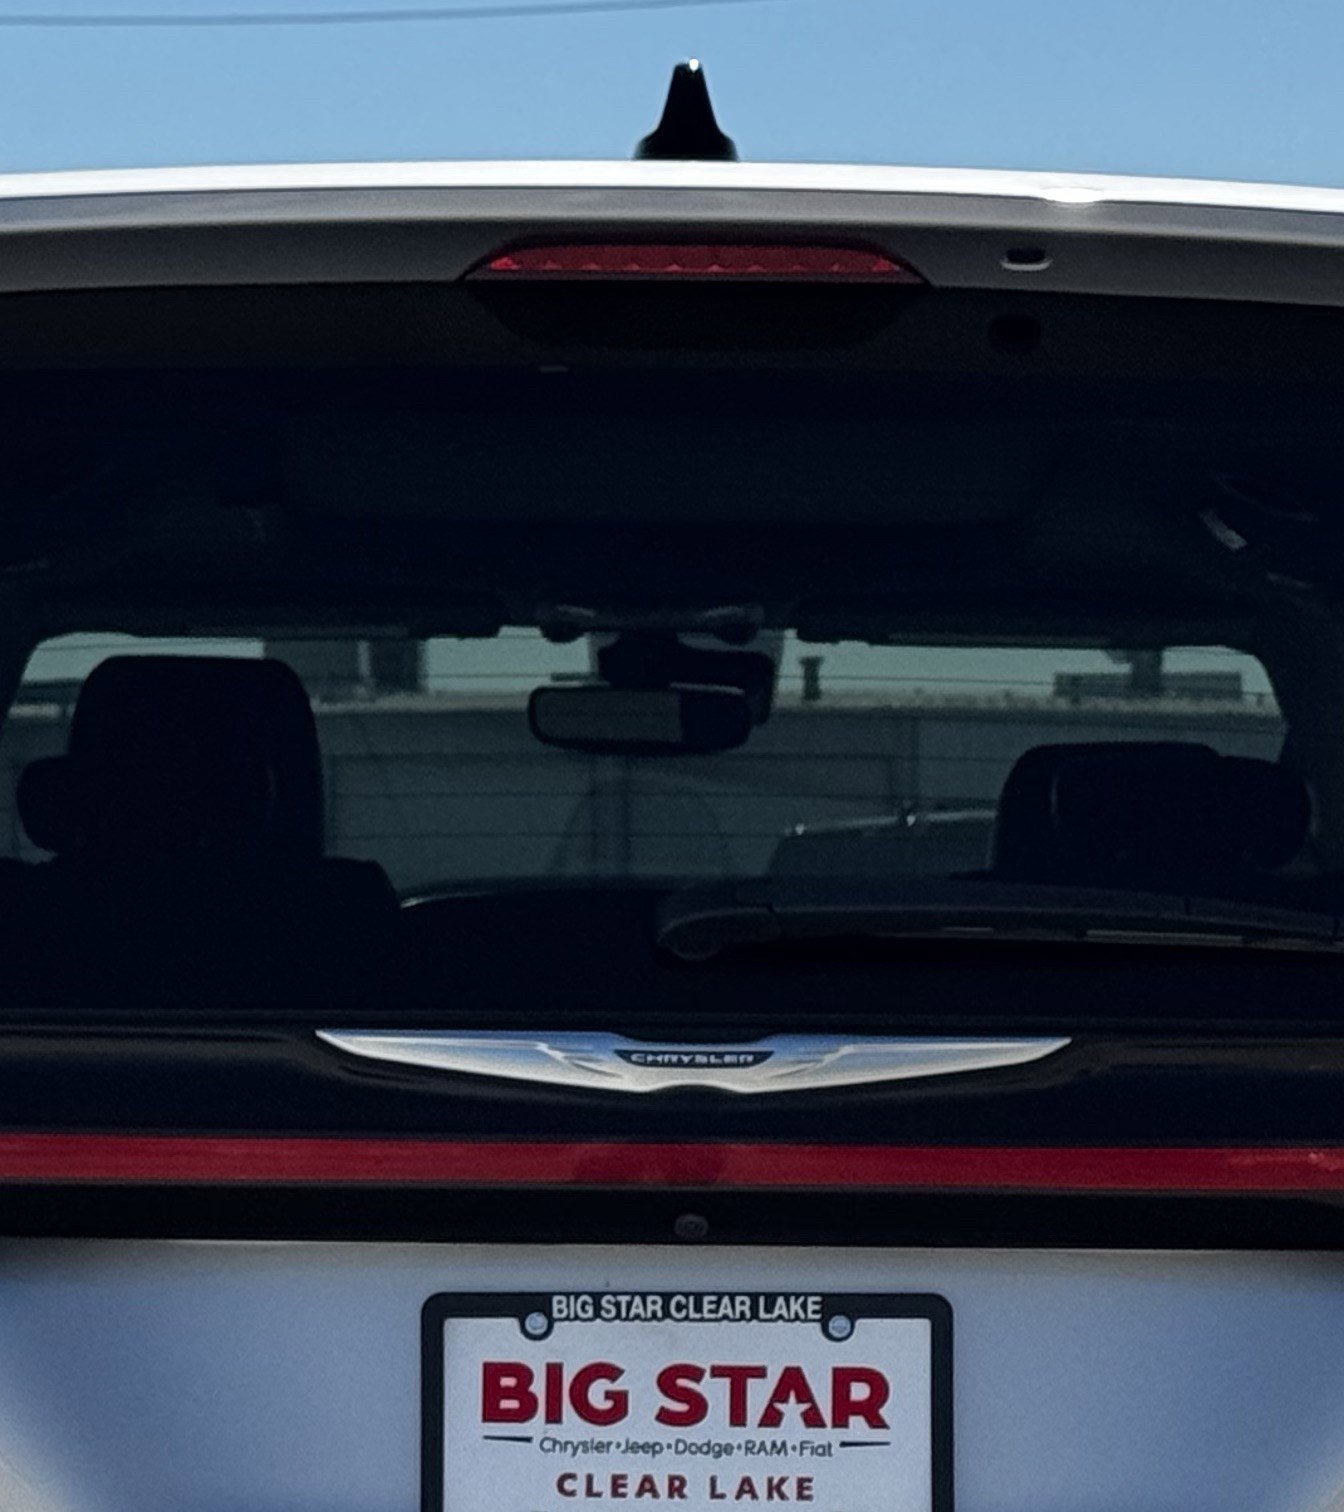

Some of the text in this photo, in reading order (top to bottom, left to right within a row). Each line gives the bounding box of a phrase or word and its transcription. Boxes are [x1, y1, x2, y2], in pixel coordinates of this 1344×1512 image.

[630, 1052, 755, 1064] CHRYSLER
[552, 1295, 822, 1320] BIG STAR CLEAR LAKE
[481, 1361, 890, 1429] BIG STAR
[556, 1472, 814, 1501] CLEAR LAKE
